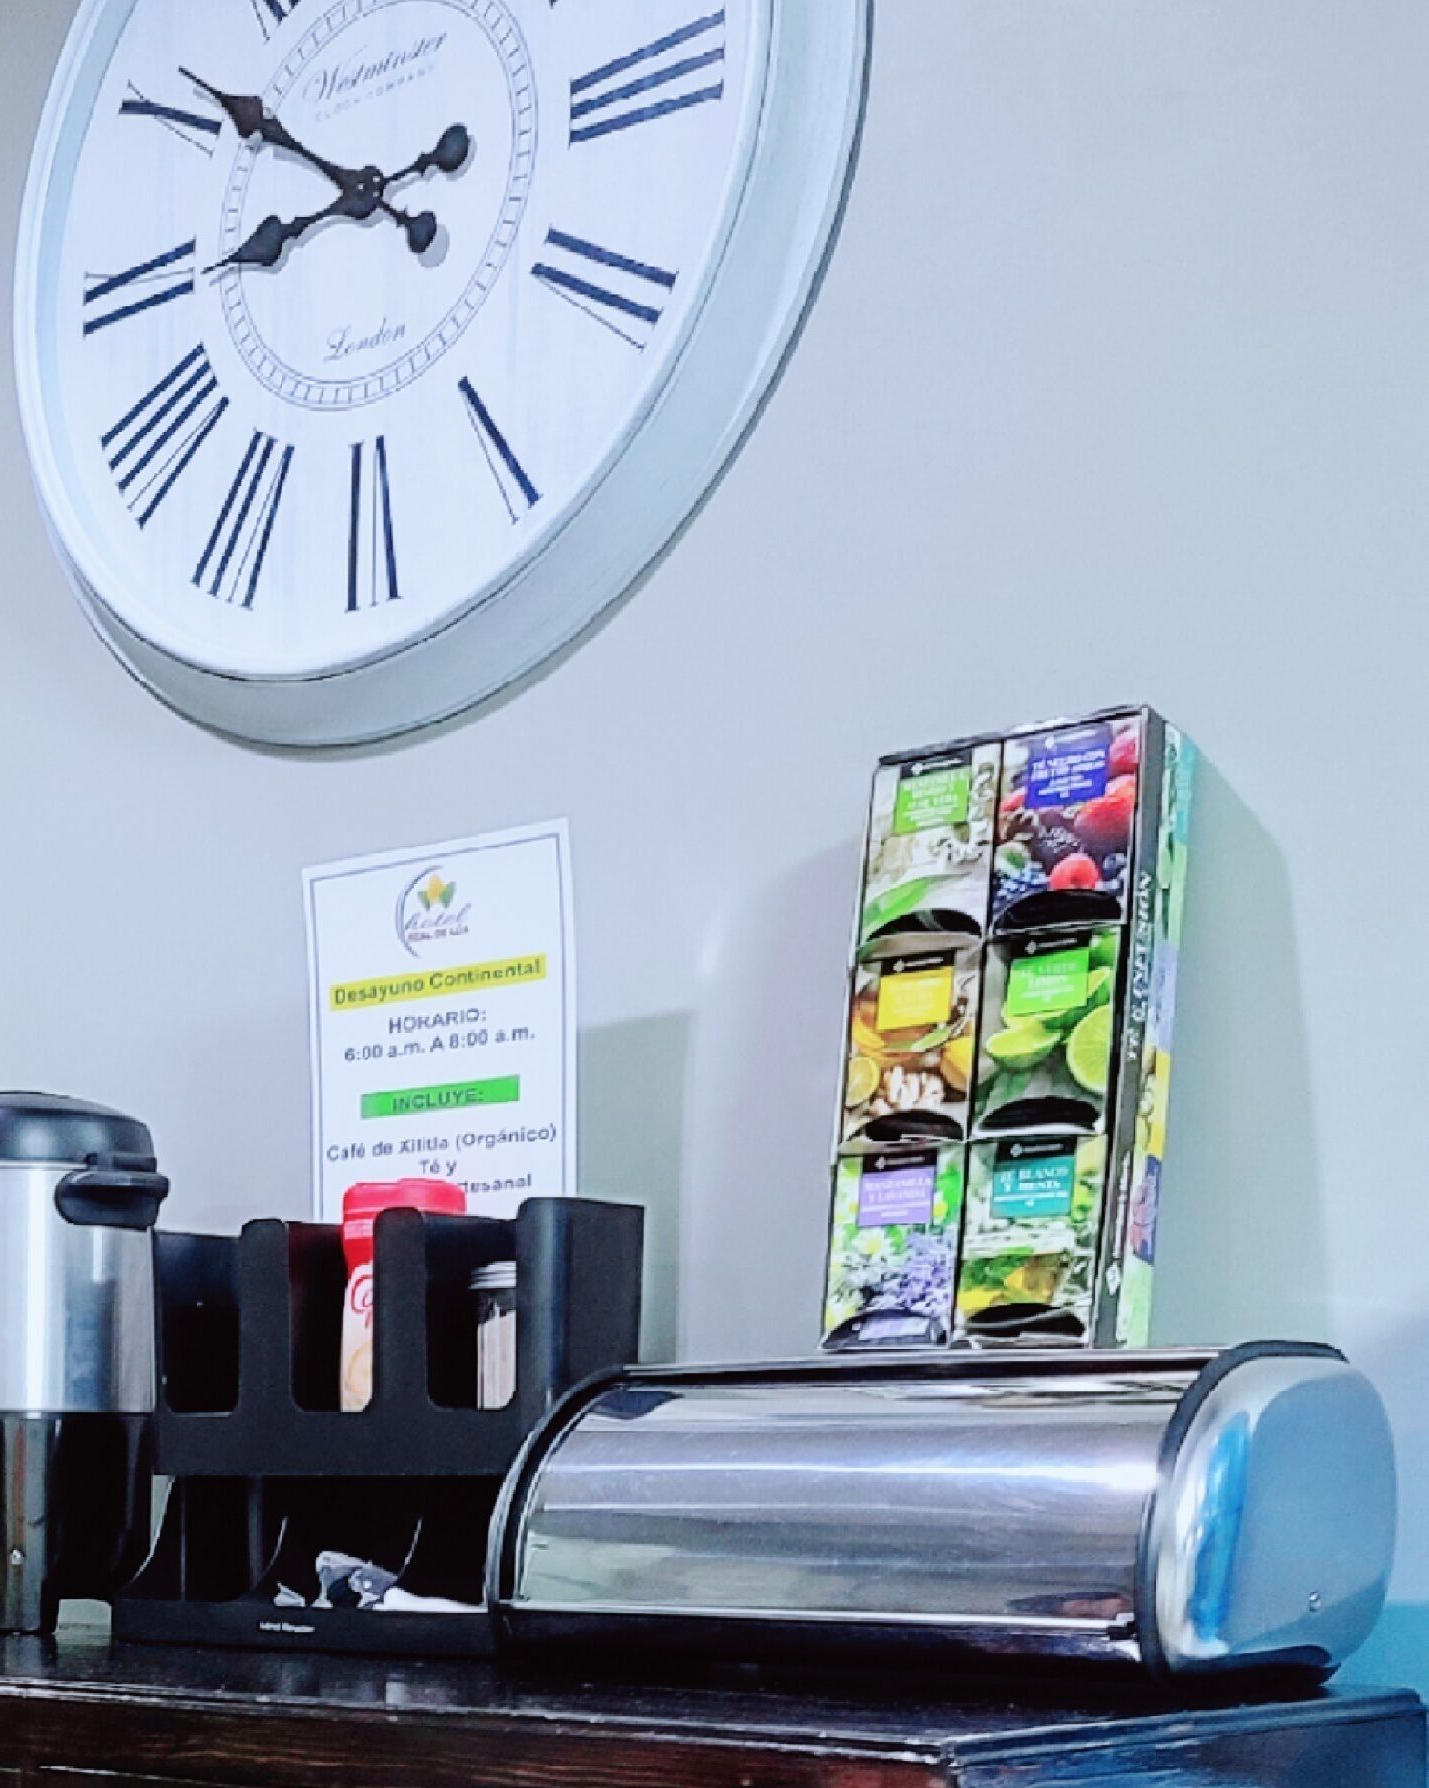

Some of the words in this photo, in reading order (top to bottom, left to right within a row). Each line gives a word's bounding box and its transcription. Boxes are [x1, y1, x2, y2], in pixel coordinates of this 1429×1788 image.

[302, 32, 447, 101] Westminster
[323, 316, 406, 364] London
[334, 977, 425, 1006] Desayuno
[429, 958, 540, 990] Continental
[388, 1007, 487, 1034] HORARIO:
[343, 1045, 384, 1062] 6:00
[387, 1042, 425, 1058] a.m.
[429, 1036, 445, 1053] A
[449, 1028, 489, 1050] 8:00
[494, 1026, 536, 1044] a.m.
[392, 1087, 485, 1112] INCLUYE:
[326, 1142, 366, 1162] Café
[372, 1140, 394, 1157] de
[397, 1136, 449, 1154] Xilitla
[455, 1121, 557, 1152] (Orgánico)
[419, 1158, 441, 1175] Té
[445, 1160, 458, 1177] y
